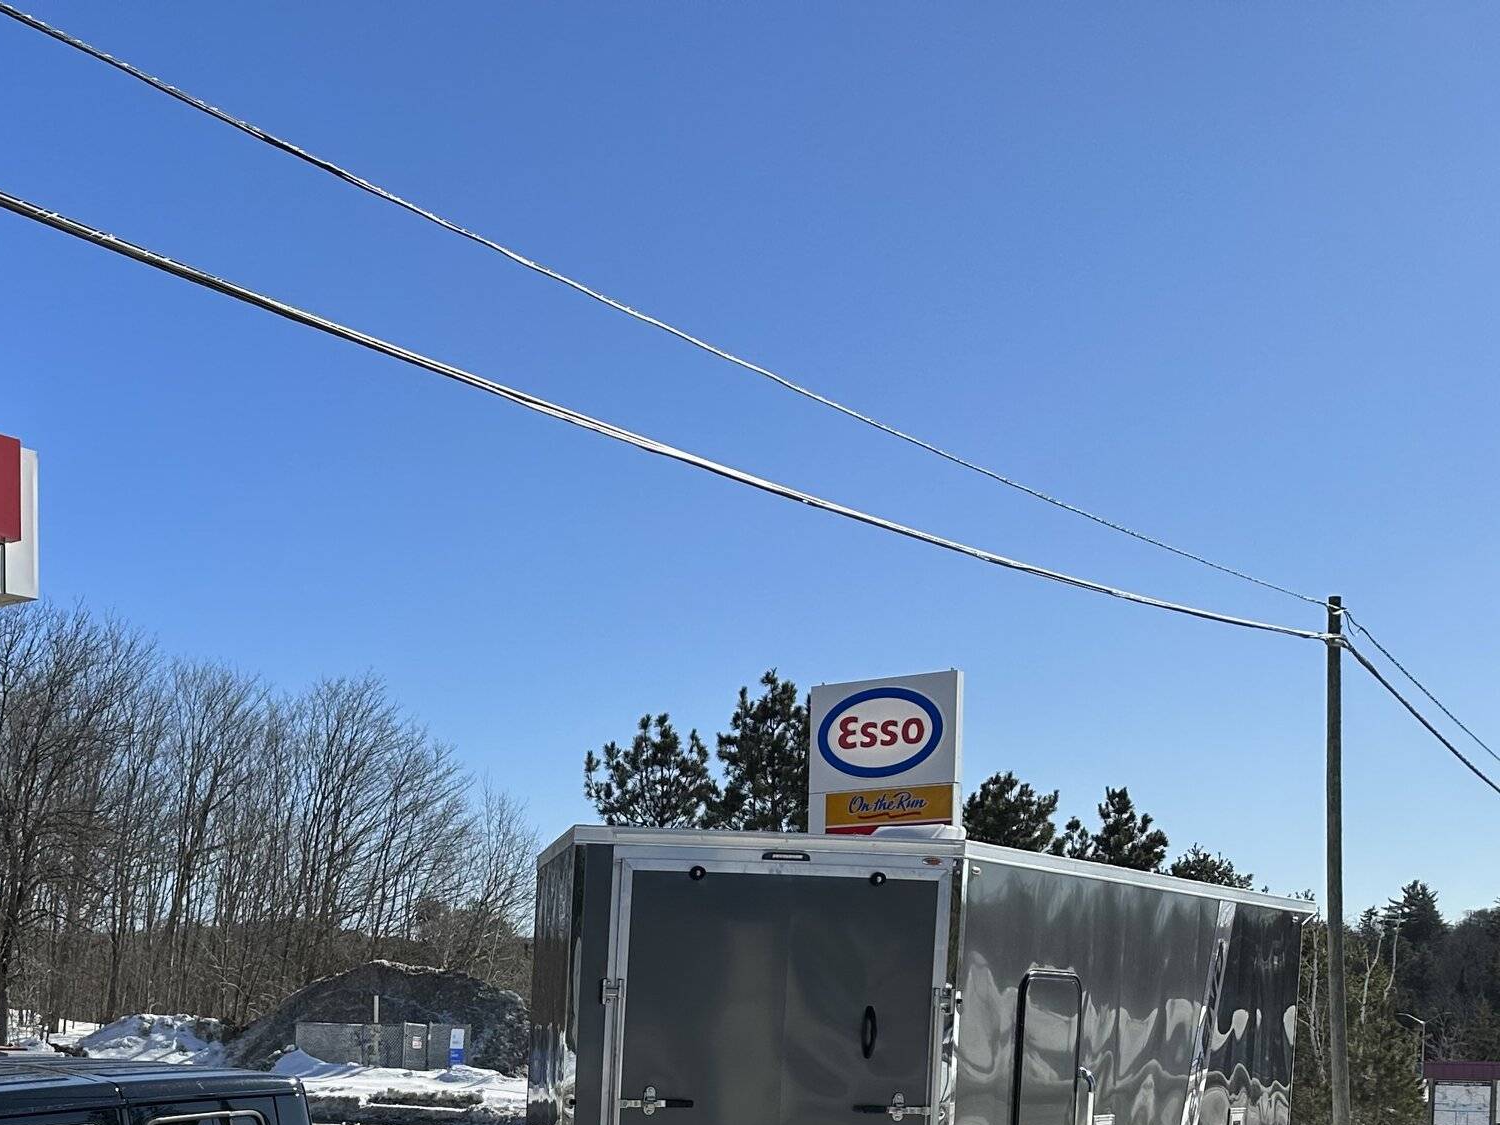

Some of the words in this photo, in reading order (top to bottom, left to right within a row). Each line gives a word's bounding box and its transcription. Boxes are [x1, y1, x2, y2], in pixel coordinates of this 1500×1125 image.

[837, 715, 926, 751] Esso
[849, 796, 871, 814] On
[873, 795, 896, 812] the
[894, 791, 928, 812] Run
